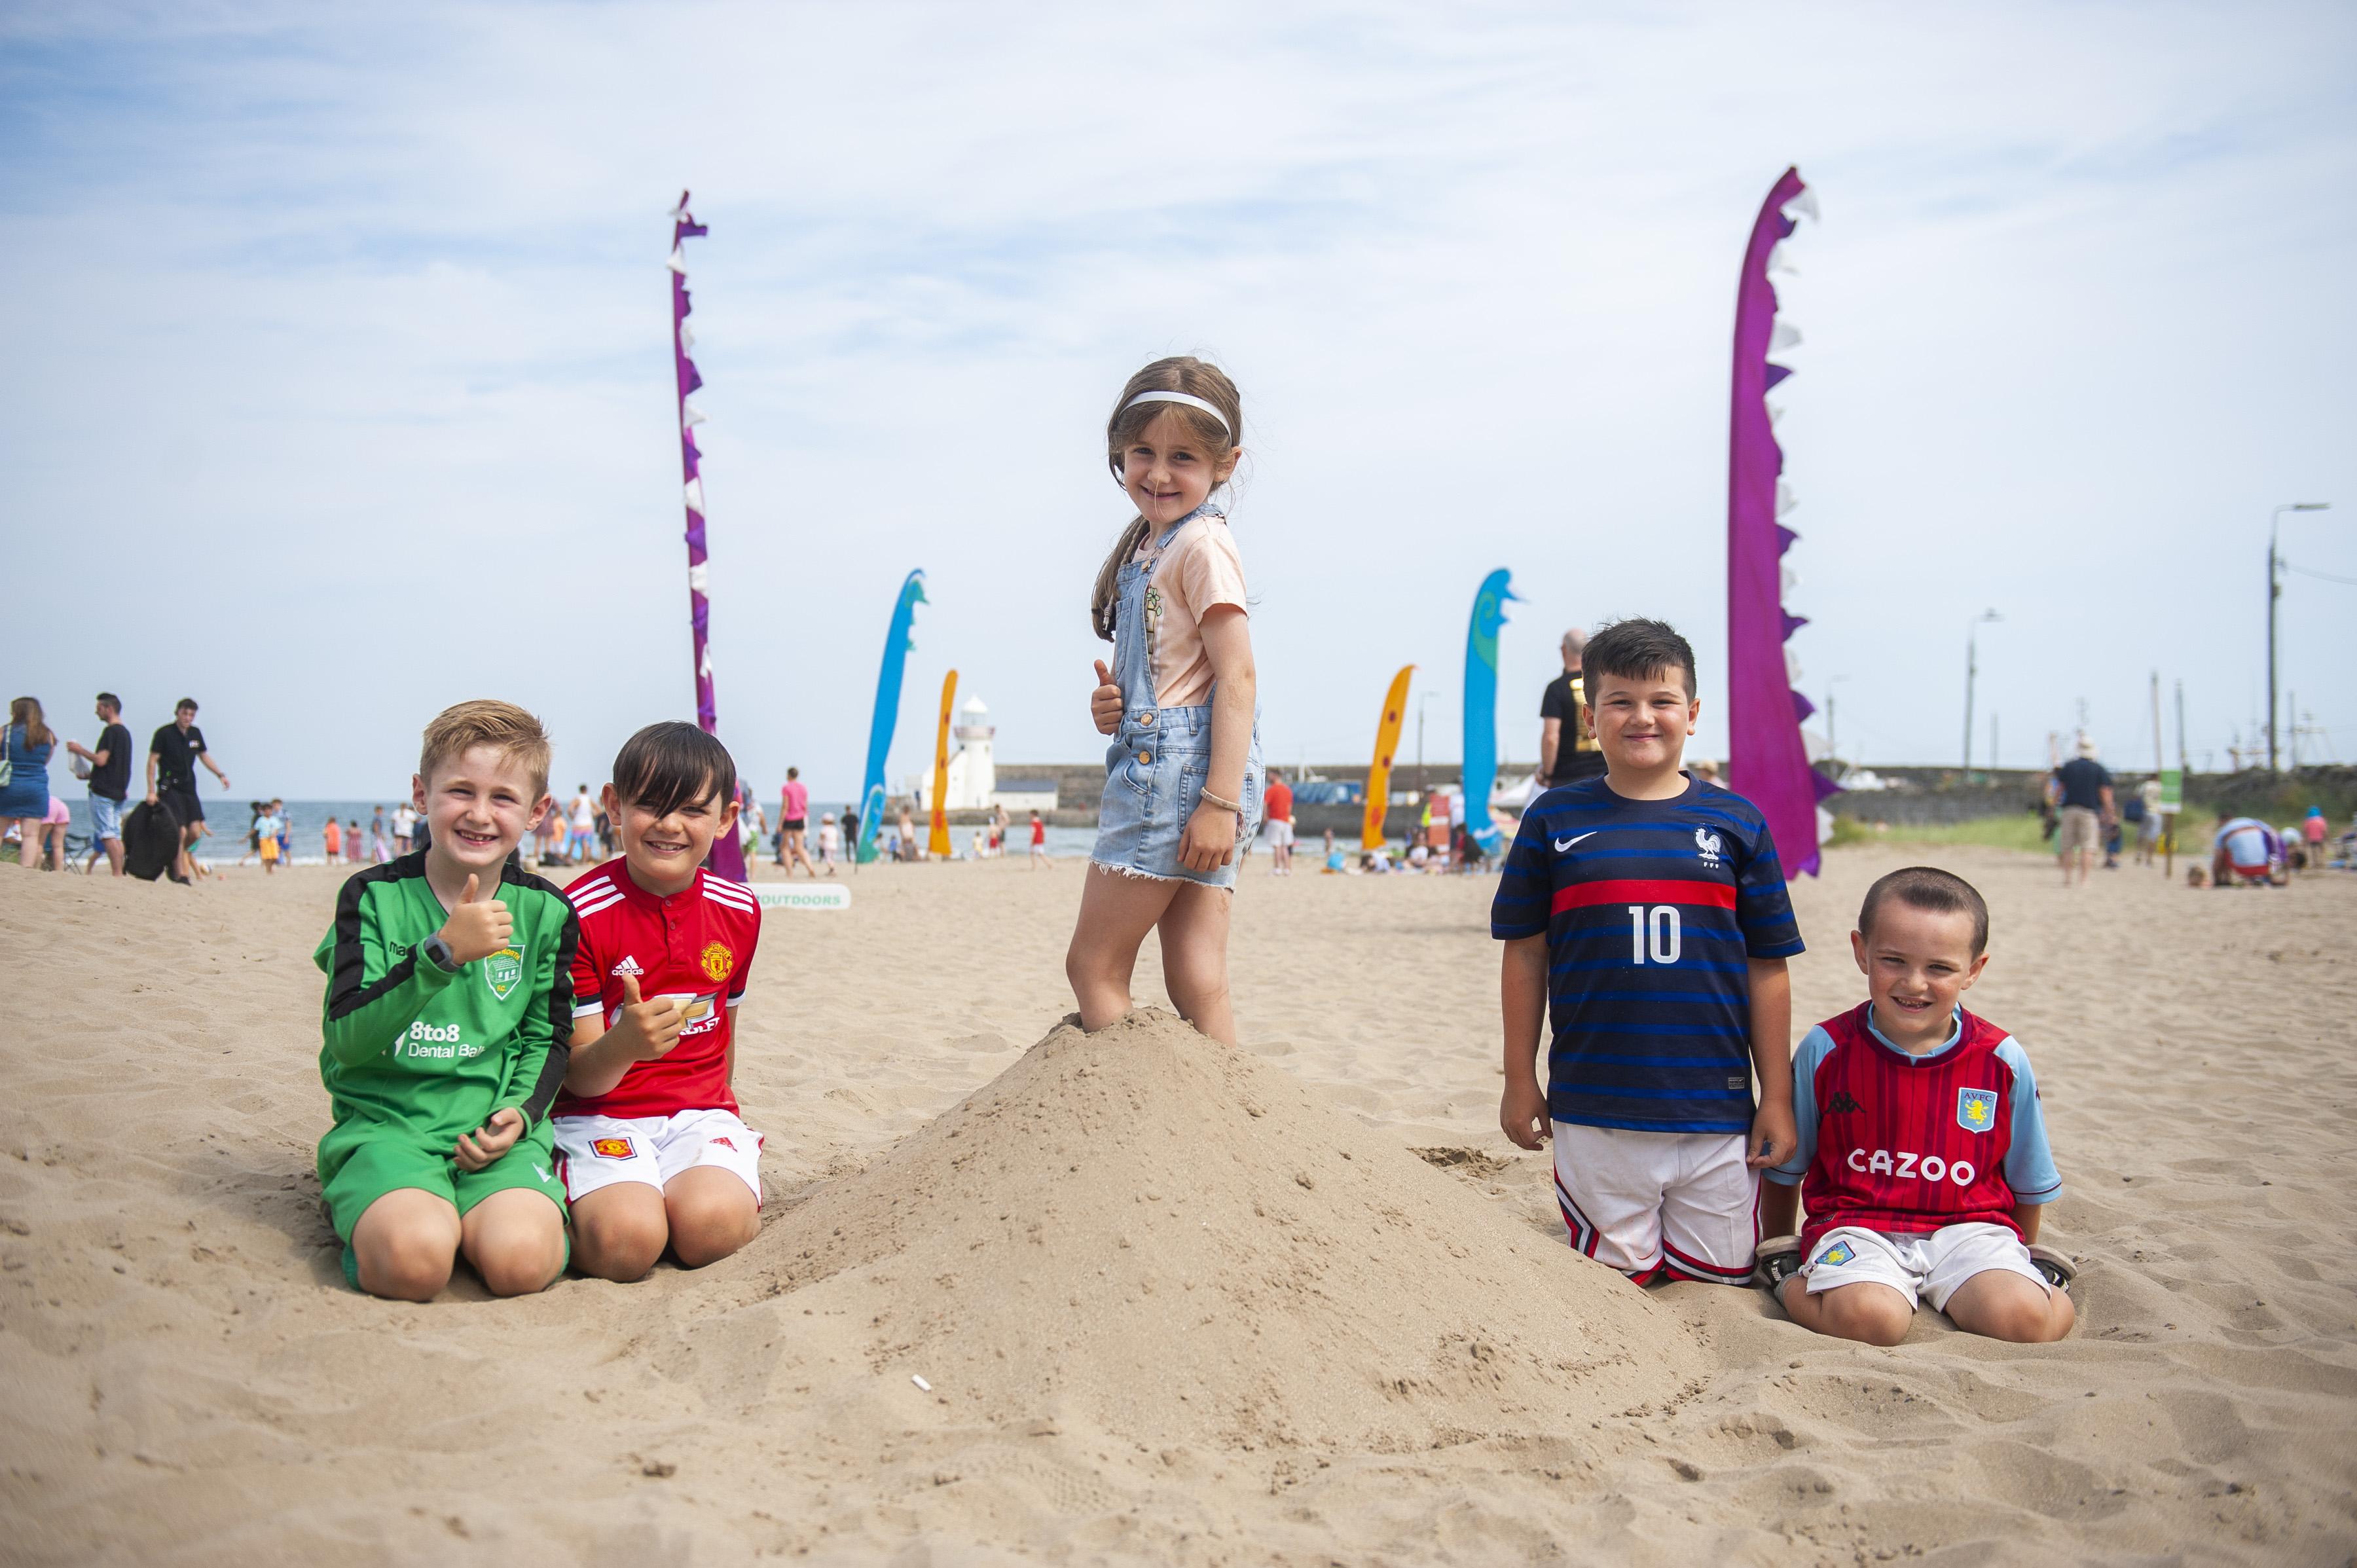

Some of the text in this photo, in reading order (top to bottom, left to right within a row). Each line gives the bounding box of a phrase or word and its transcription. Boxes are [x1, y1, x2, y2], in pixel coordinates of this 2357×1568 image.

[1628, 905, 1681, 964] 10
[409, 1021, 460, 1042] 8to8
[408, 1043, 455, 1058] Dental
[1964, 1092, 1992, 1102] AVFC
[1848, 1148, 1975, 1186] CAZOO
[1772, 1266, 1781, 1281] NIKE
